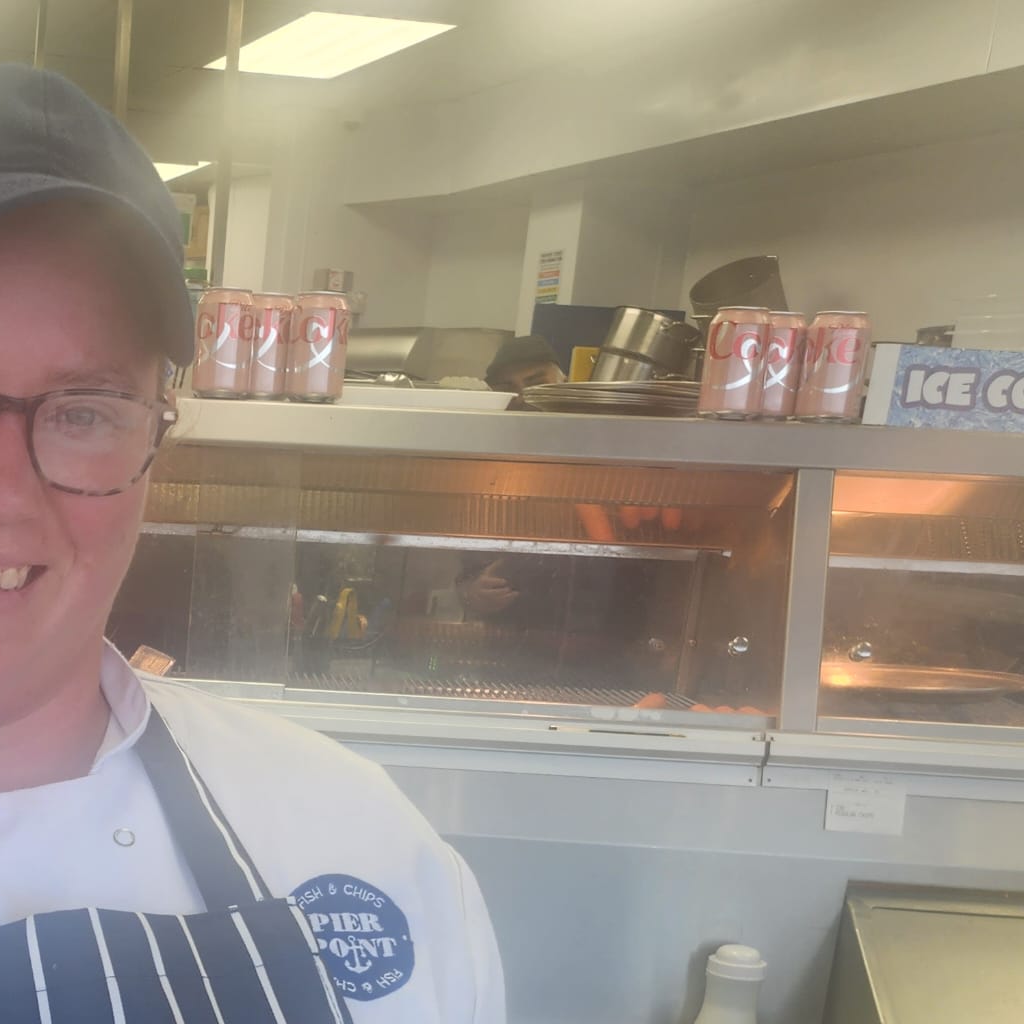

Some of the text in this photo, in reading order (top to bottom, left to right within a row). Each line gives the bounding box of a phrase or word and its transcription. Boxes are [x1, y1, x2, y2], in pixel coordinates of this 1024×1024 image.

[903, 366, 979, 410] ICE
[297, 883, 385, 910] FISH & CHIPS
[306, 912, 385, 933] PIER
